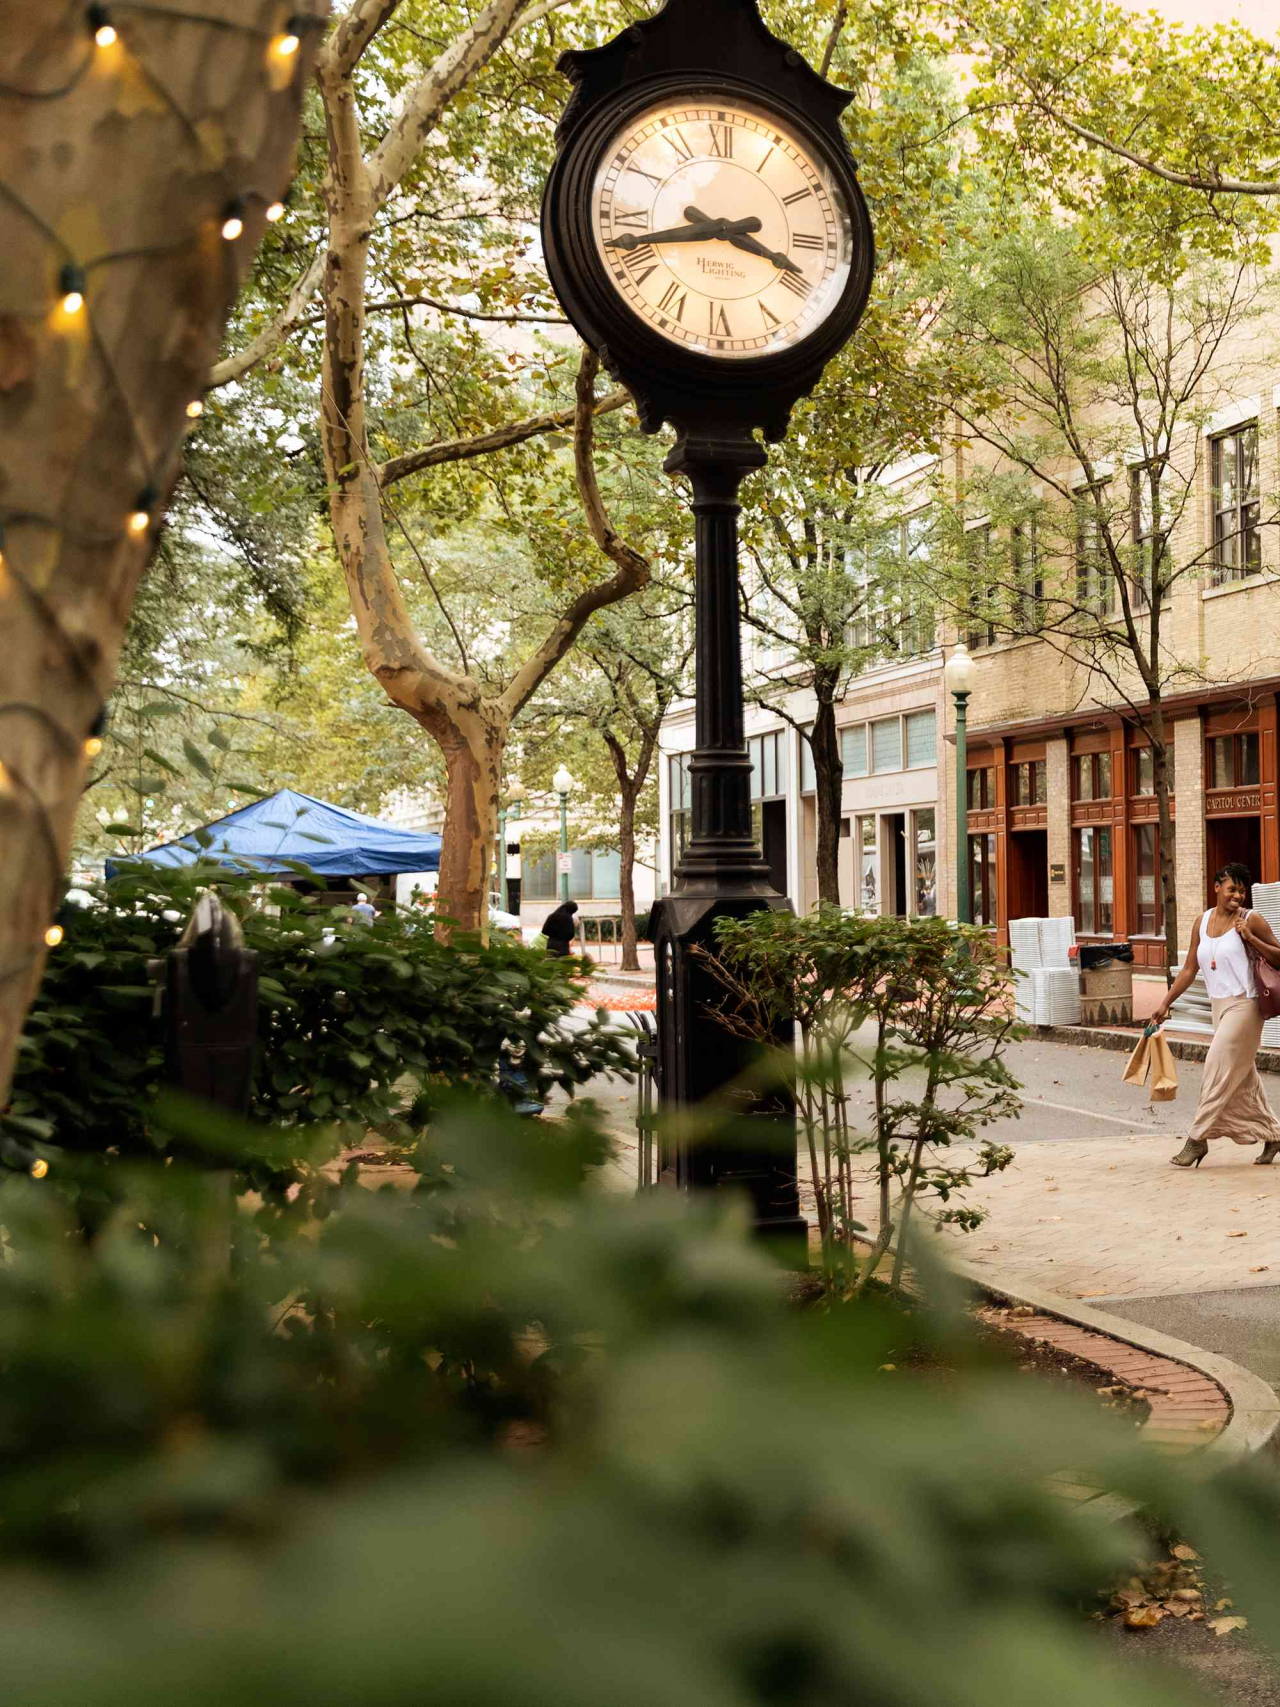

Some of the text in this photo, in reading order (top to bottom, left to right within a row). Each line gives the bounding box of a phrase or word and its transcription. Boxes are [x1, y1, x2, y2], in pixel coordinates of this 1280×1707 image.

[697, 257, 735, 270] HERWIG
[702, 266, 746, 279] LIGHTING
[1206, 796, 1235, 810] CAPITOL
